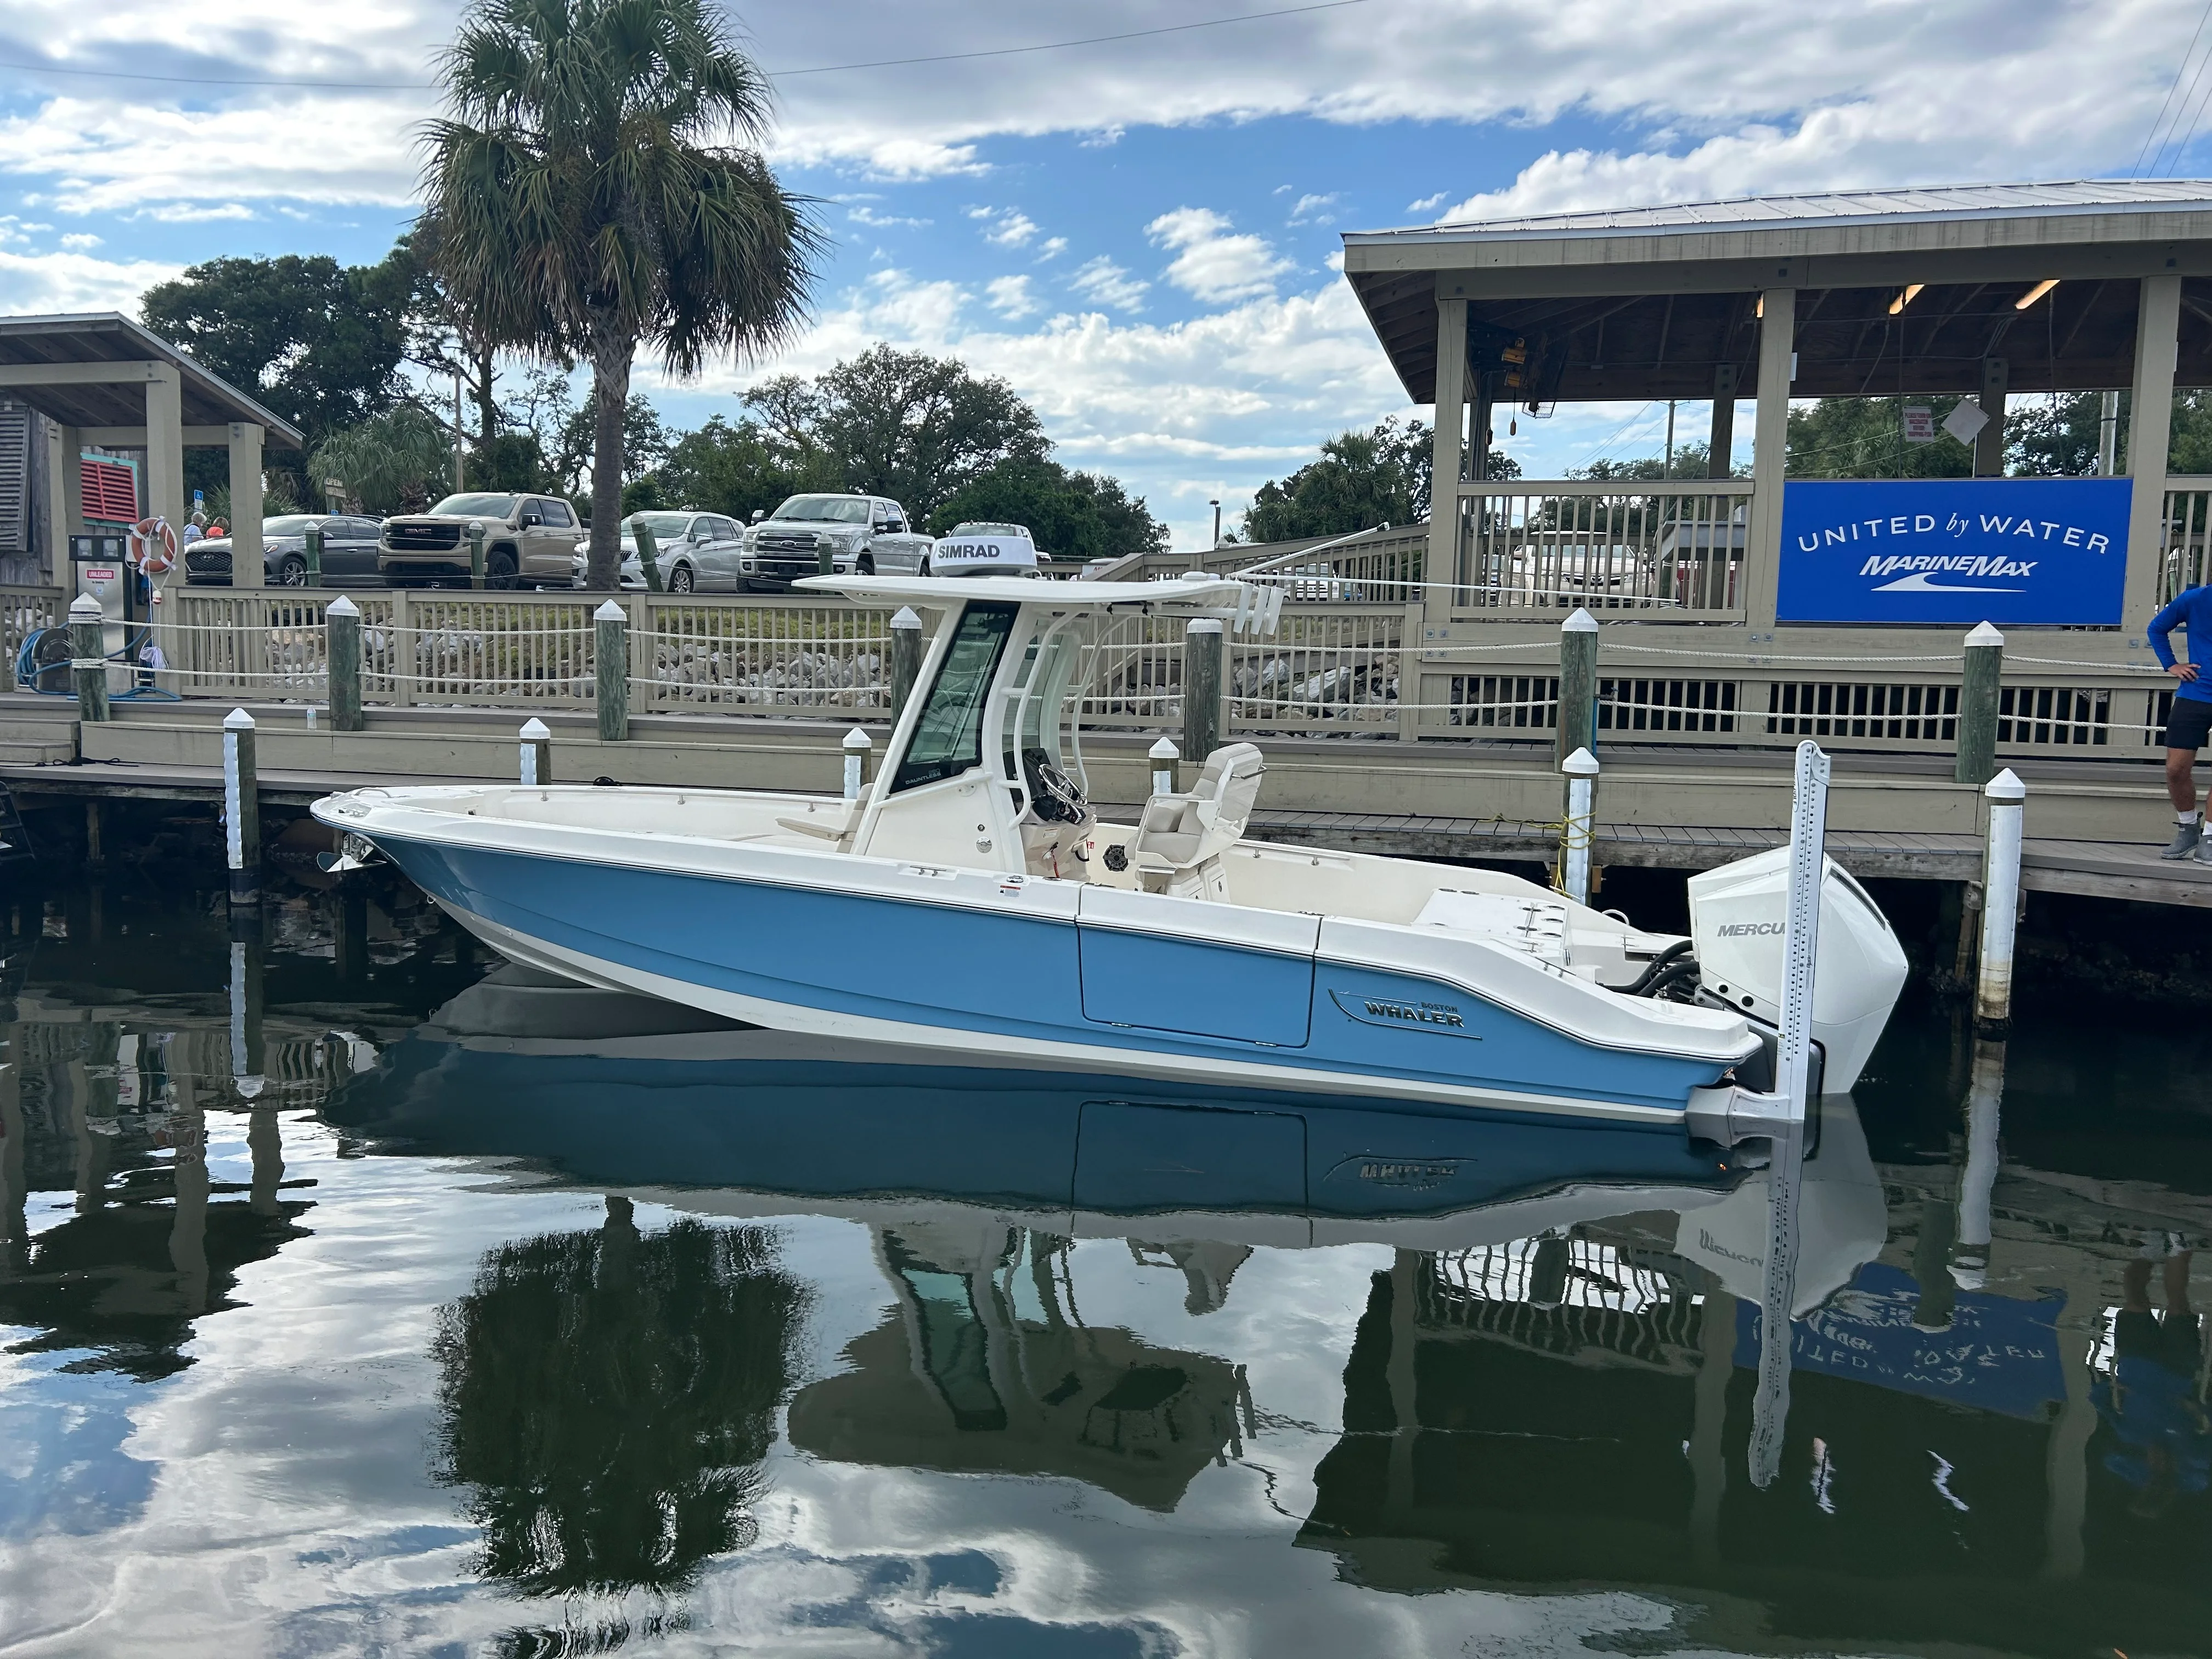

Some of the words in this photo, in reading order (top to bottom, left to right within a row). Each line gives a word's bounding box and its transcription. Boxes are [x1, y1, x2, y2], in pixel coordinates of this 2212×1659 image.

[326, 477, 343, 487] OPEN
[1798, 515, 1936, 551] UNITED
[1946, 512, 1968, 538] by
[1979, 515, 2109, 554] WATER
[938, 545, 1000, 558] SIMRAD
[905, 772, 941, 785] DAUNTLESS
[1717, 922, 1785, 937] MERCU
[1421, 1002, 1458, 1013] BOSTON
[1363, 1001, 1464, 1028] WHALER
